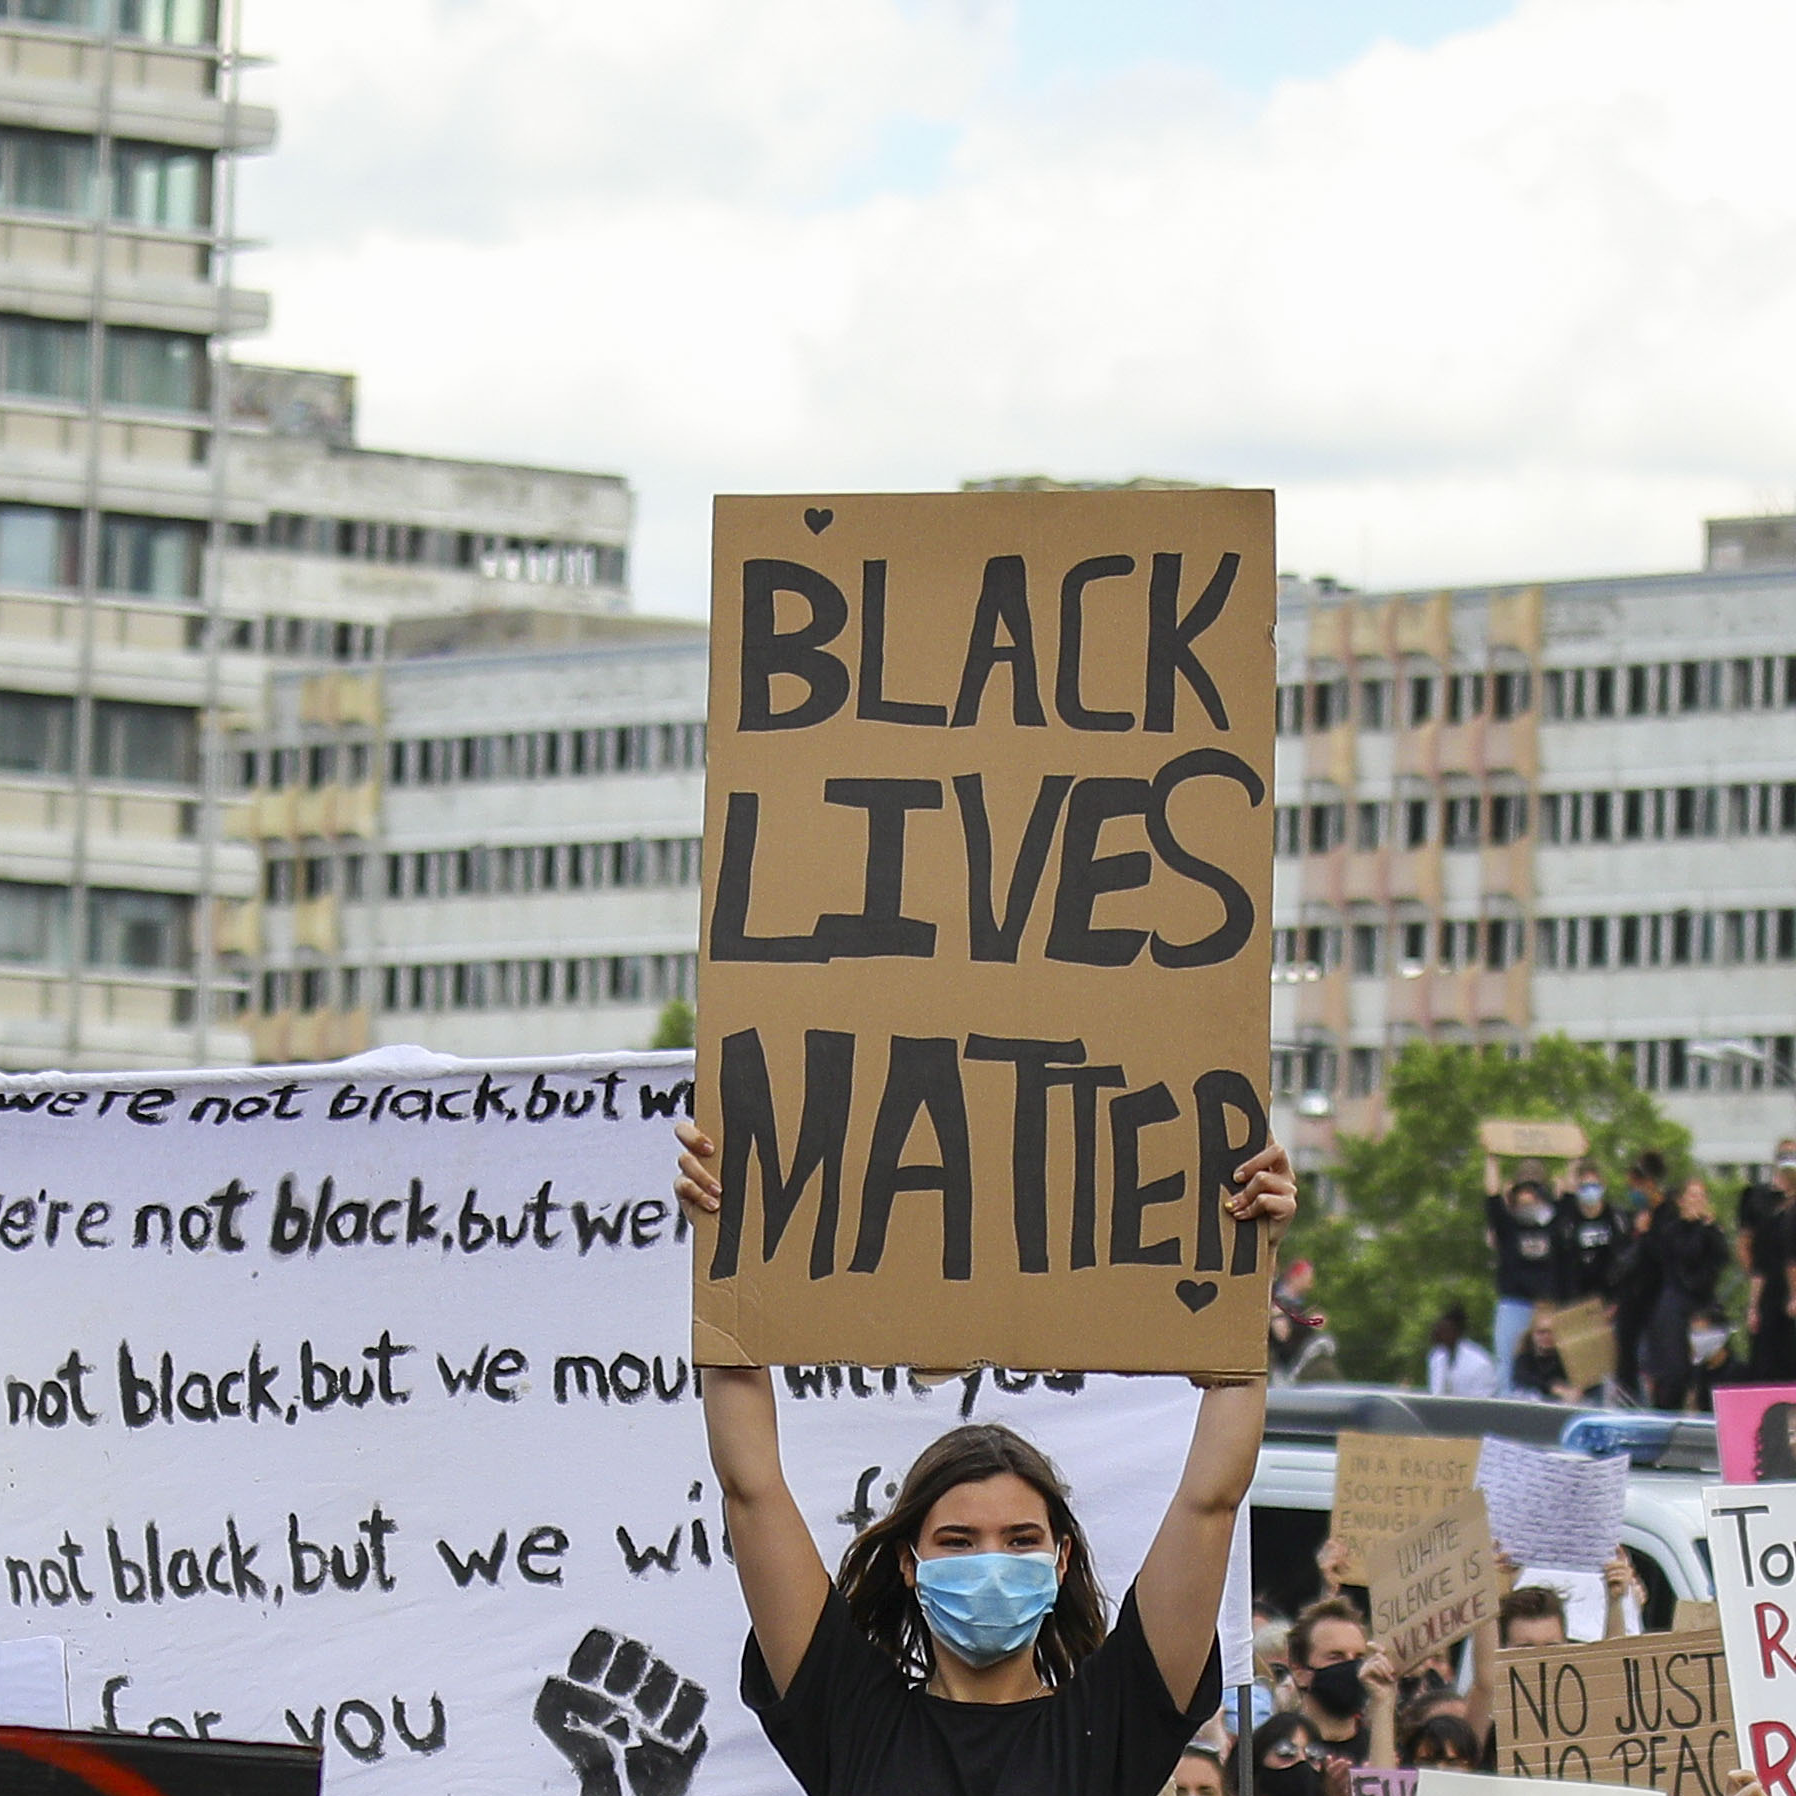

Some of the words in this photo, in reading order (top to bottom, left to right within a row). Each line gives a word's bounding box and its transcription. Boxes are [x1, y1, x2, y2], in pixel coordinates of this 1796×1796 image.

[736, 552, 1241, 734] BLACK
[708, 748, 1265, 968] LIVES
[187, 1082, 311, 1126] not
[708, 1027, 1266, 1281] MATTER
[130, 1176, 257, 1255] not
[570, 1196, 669, 1257] we
[7, 1347, 98, 1430] not
[434, 1342, 529, 1404] we
[4, 1527, 95, 1607] not
[434, 1520, 571, 1590] we
[1395, 1519, 1461, 1580] WHITE
[1375, 1566, 1454, 1635] SILENCE
[1461, 1551, 1481, 1585] IS
[1391, 1589, 1489, 1660] VIOLENCE
[284, 1688, 449, 1766] you
[1508, 1661, 1590, 1740] NO
